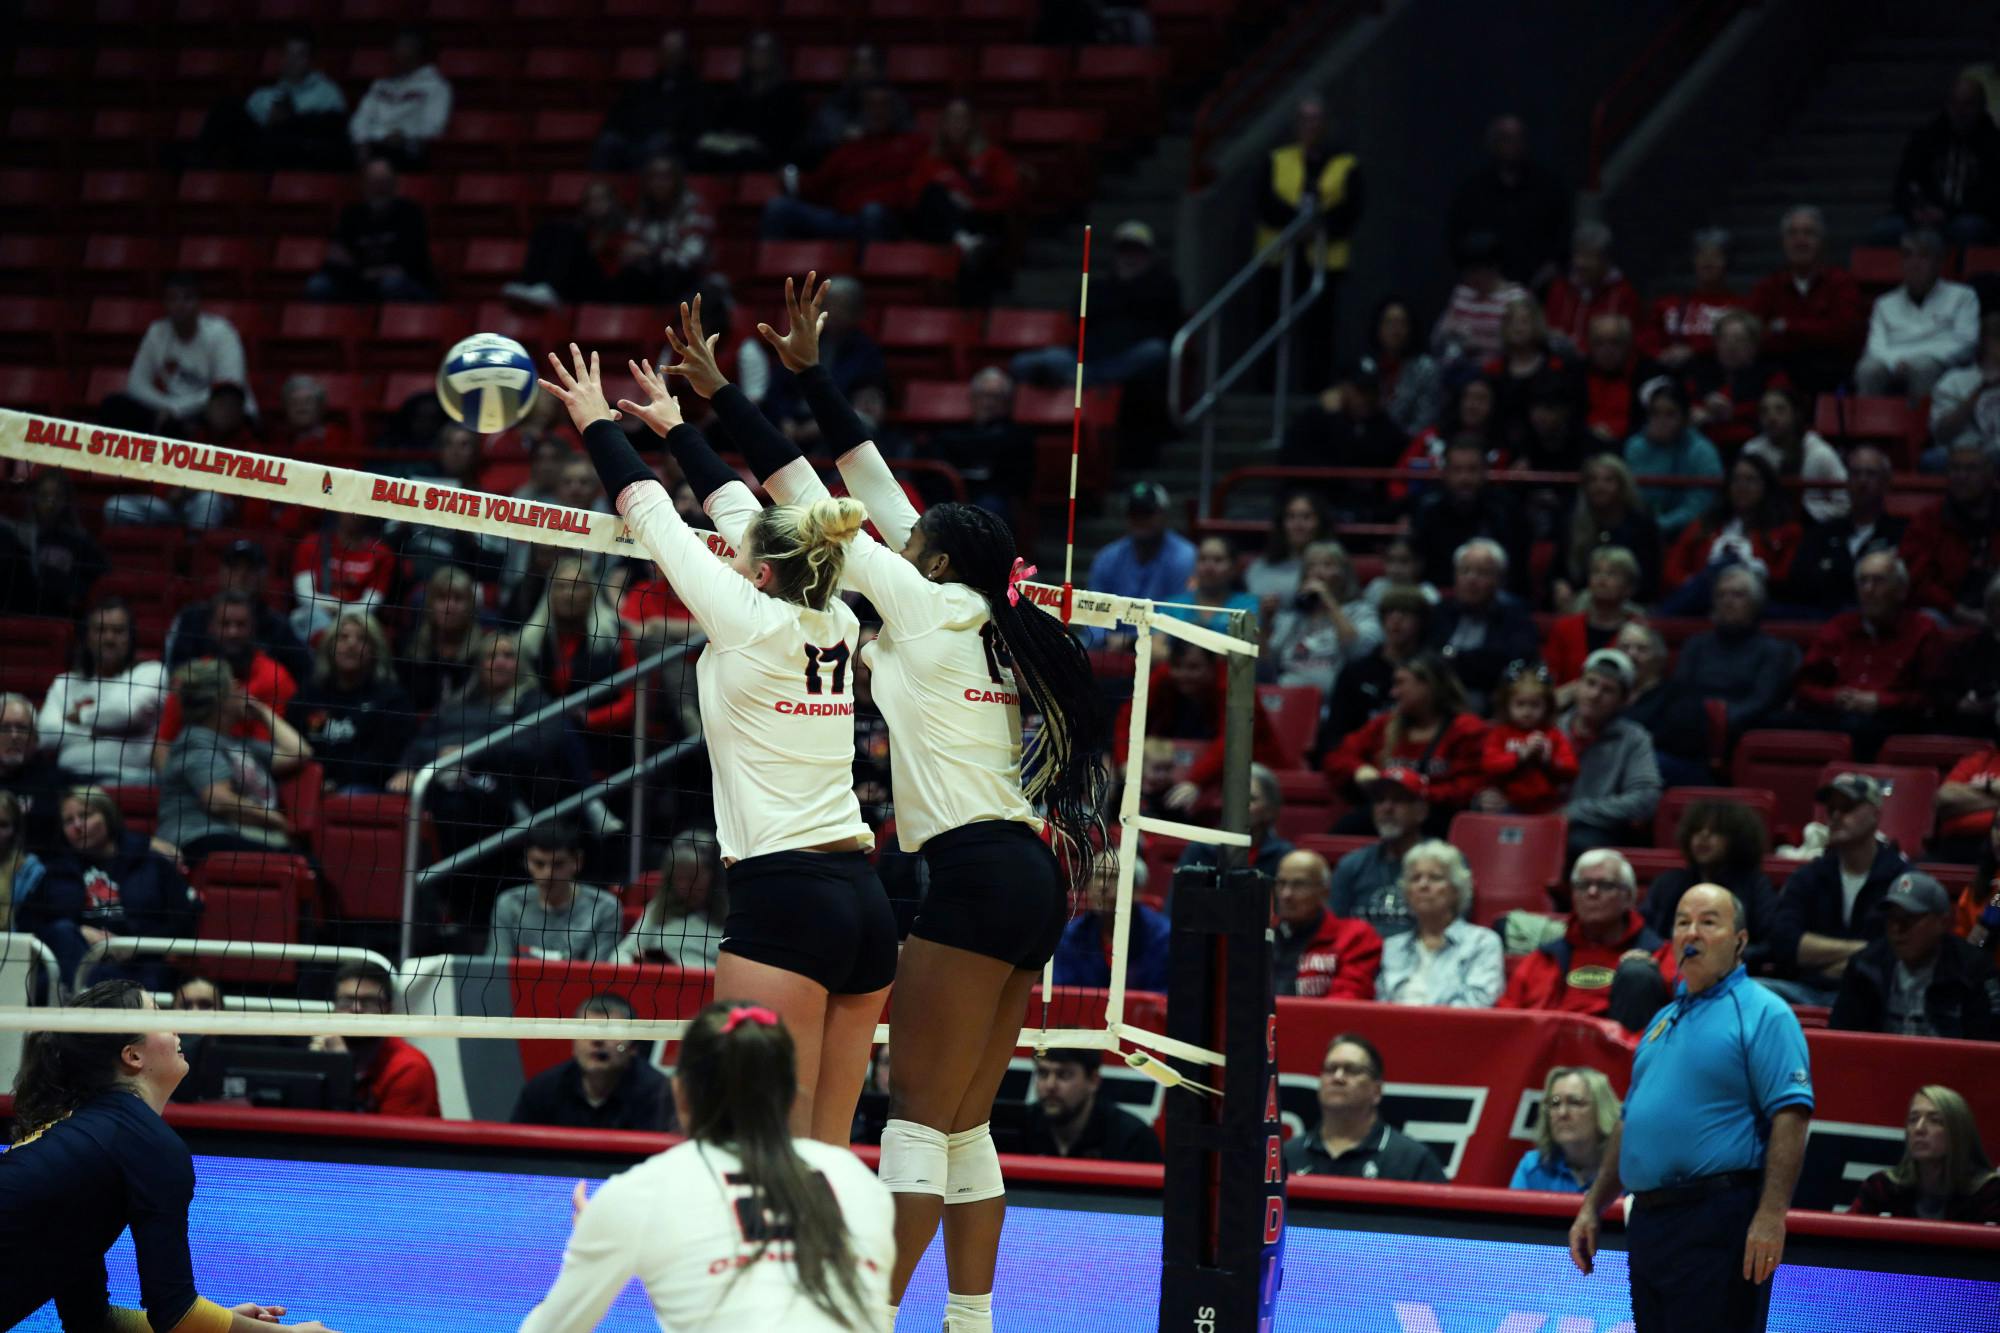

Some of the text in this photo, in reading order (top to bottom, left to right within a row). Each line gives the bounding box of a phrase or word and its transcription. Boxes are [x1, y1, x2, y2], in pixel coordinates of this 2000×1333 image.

[25, 419, 288, 486] BALL STATE VOLLEYBALL
[371, 478, 591, 535] BALL STATE VOLLEYBALL
[804, 637, 850, 695] 17
